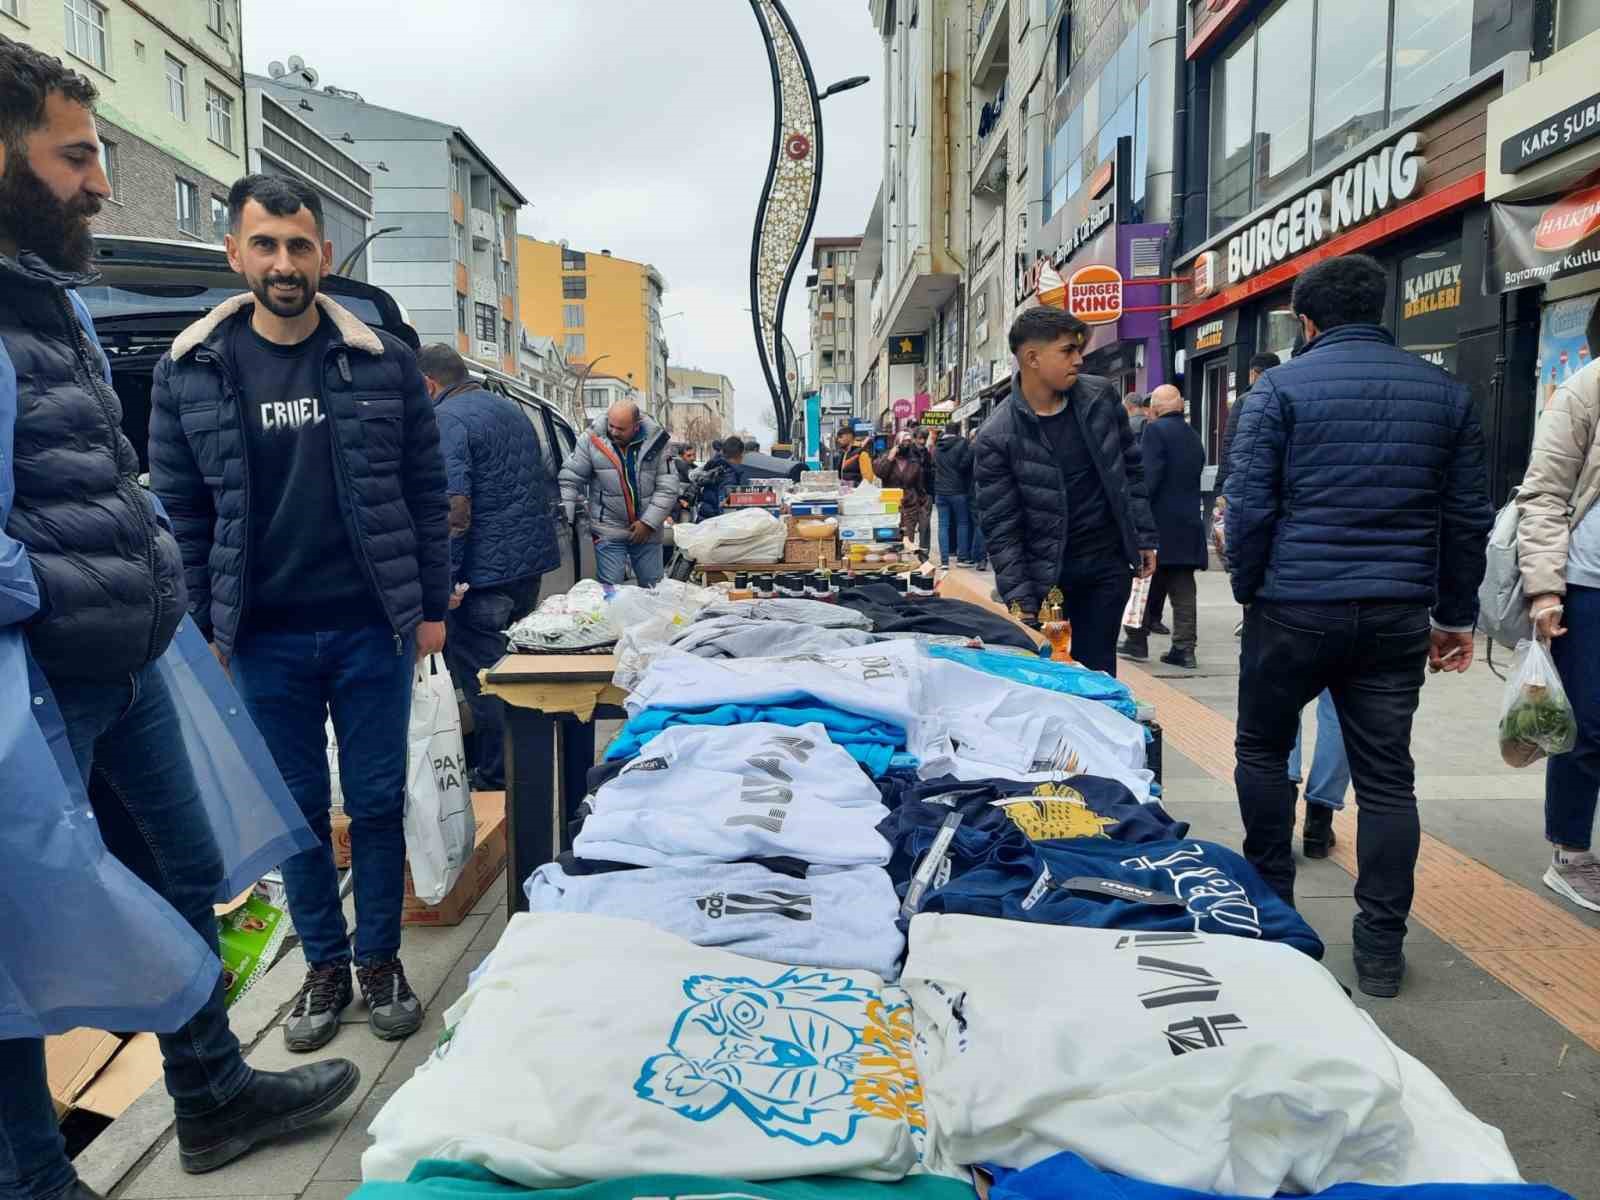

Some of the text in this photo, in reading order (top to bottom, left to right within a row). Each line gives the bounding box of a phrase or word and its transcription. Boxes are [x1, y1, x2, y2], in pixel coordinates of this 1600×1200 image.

[1521, 124, 1558, 158] KARS
[1228, 131, 1419, 283] BURGER KING
[1072, 284, 1119, 297] BURGER
[1072, 296, 1120, 313] KING
[260, 398, 326, 431] CRUEL
